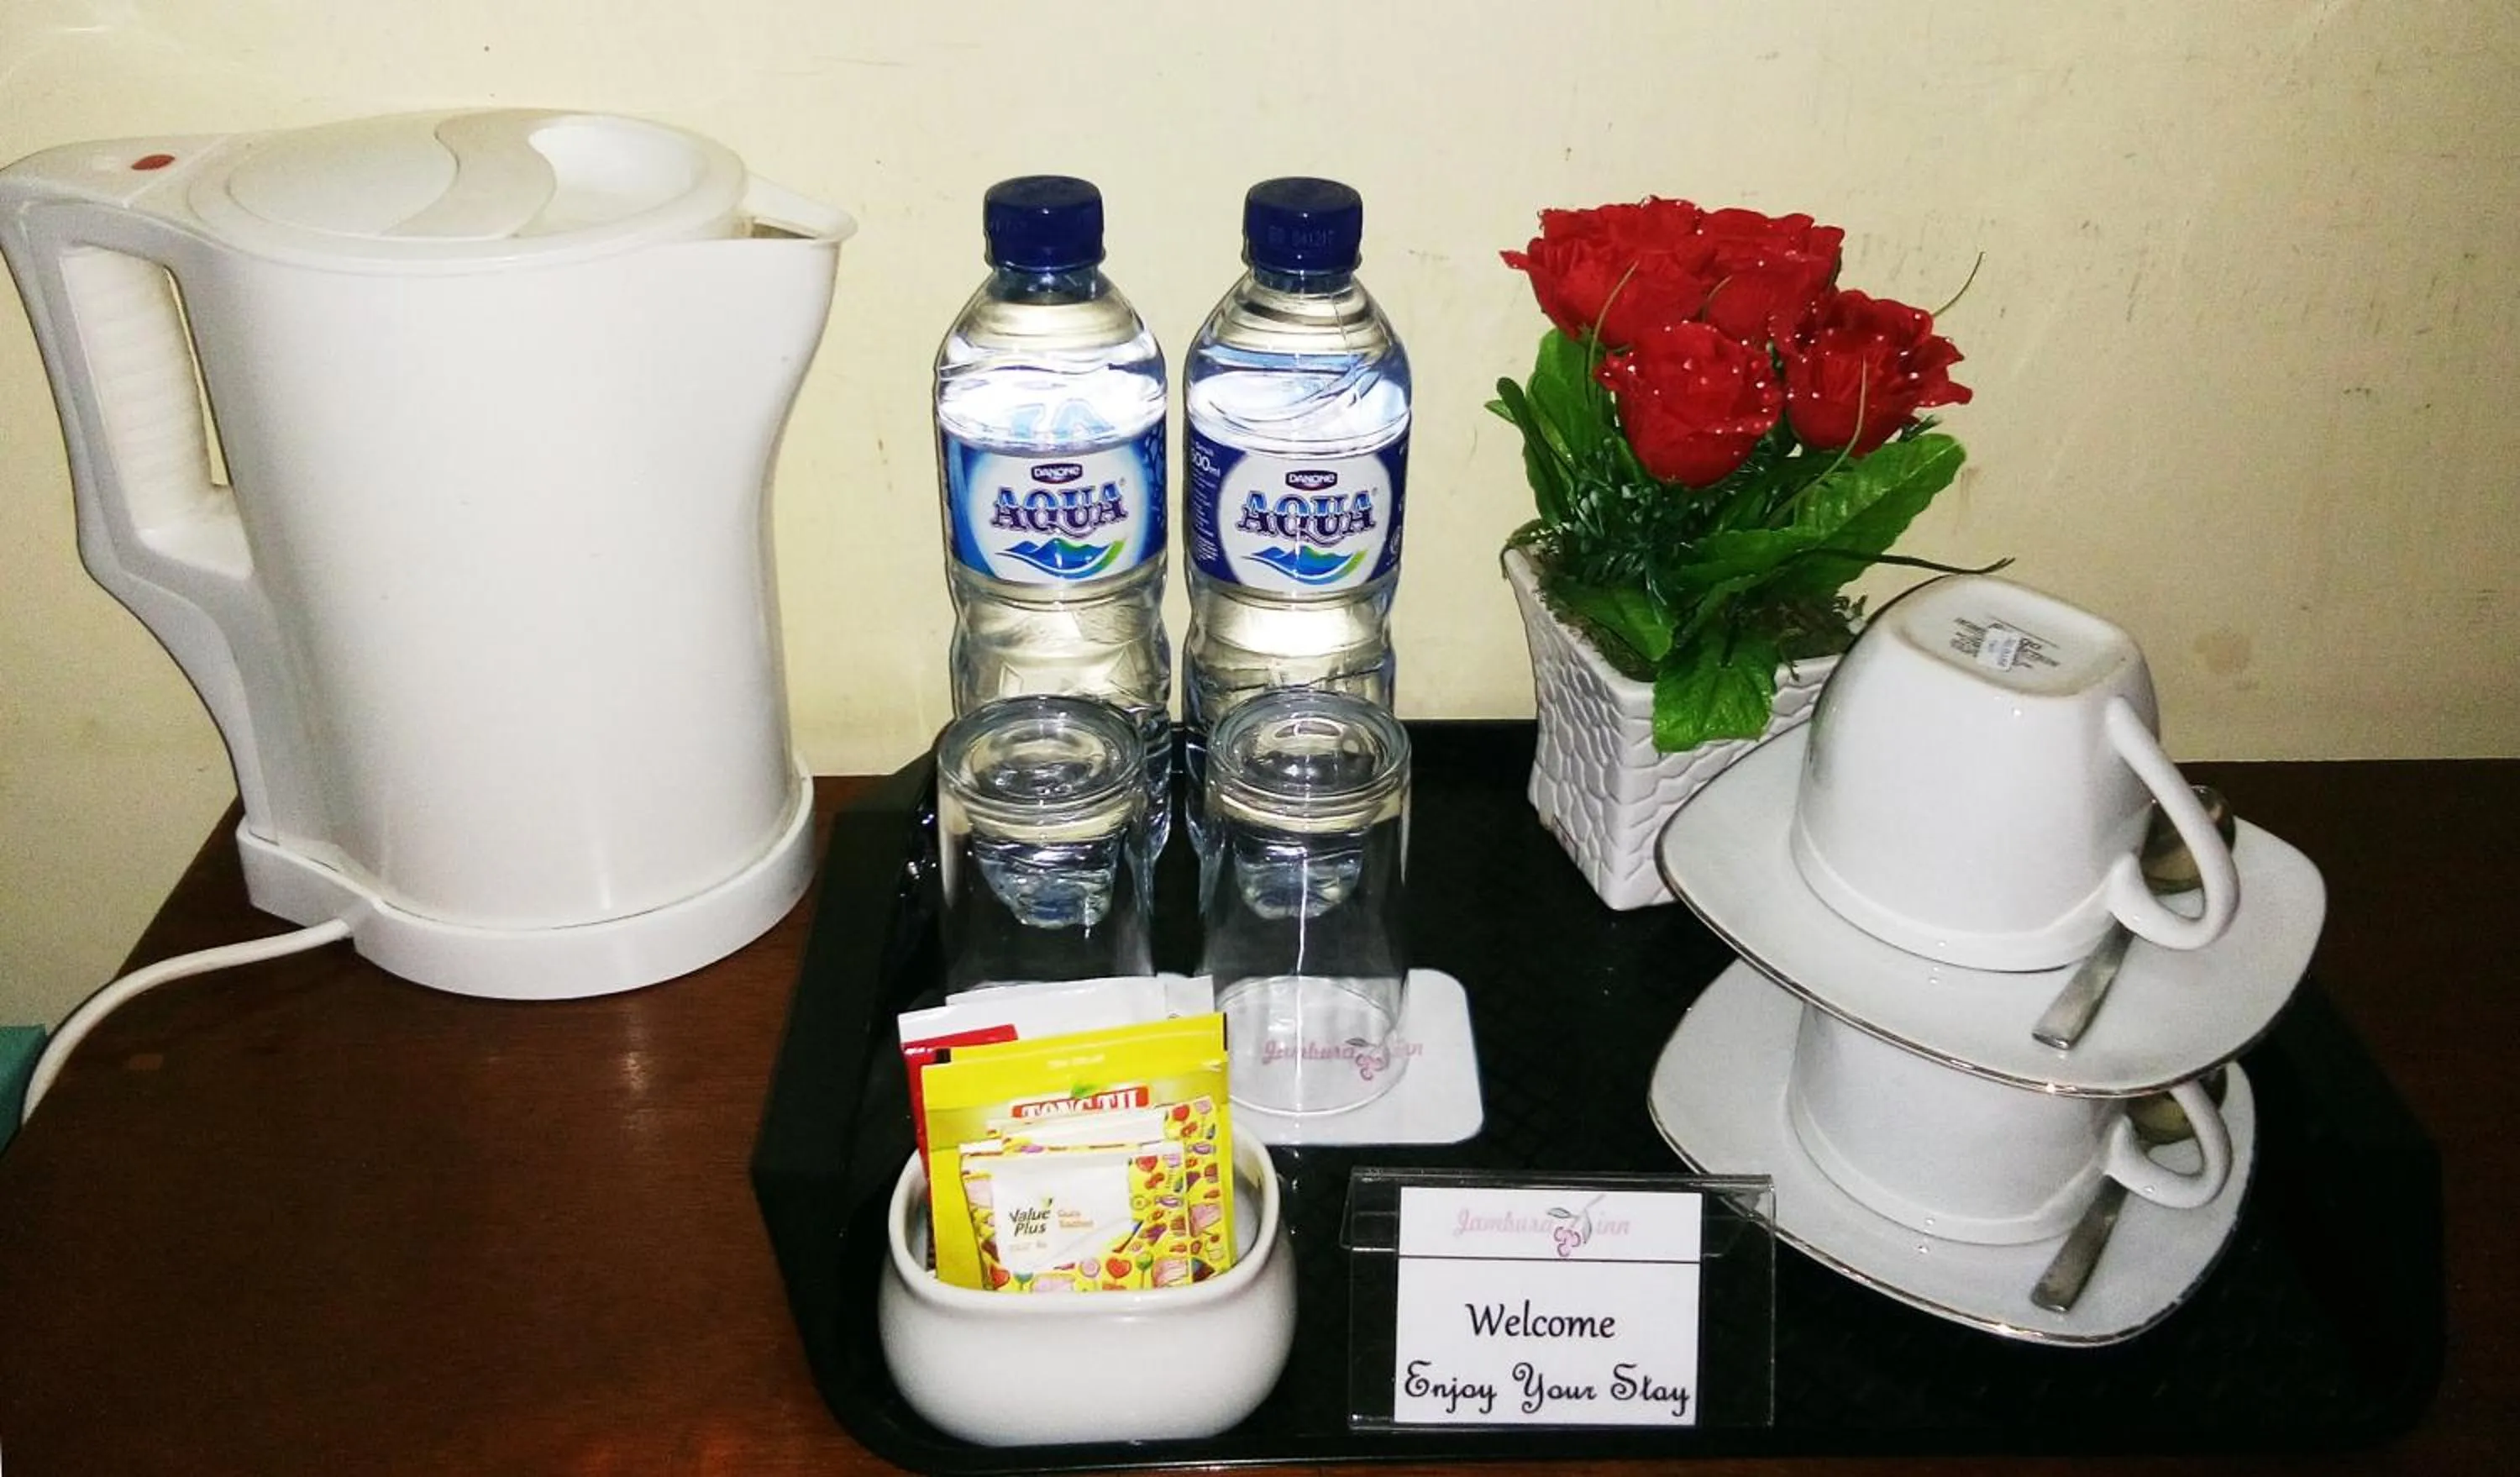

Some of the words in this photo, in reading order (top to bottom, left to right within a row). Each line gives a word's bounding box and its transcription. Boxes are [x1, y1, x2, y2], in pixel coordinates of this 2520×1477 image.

[1288, 473, 1336, 484] DANONE
[990, 481, 1128, 539] AQUA
[1235, 490, 1378, 548] AQUA
[1009, 1206, 1051, 1222] Value
[1014, 1222, 1047, 1237] Plus
[1452, 1207, 1553, 1238] Jambura
[1596, 1215, 1631, 1236] inn
[1465, 1299, 1616, 1338] Welcome
[1404, 1360, 1498, 1415] Enjoy
[1512, 1362, 1597, 1414] Your
[1610, 1363, 1691, 1417] Stay
